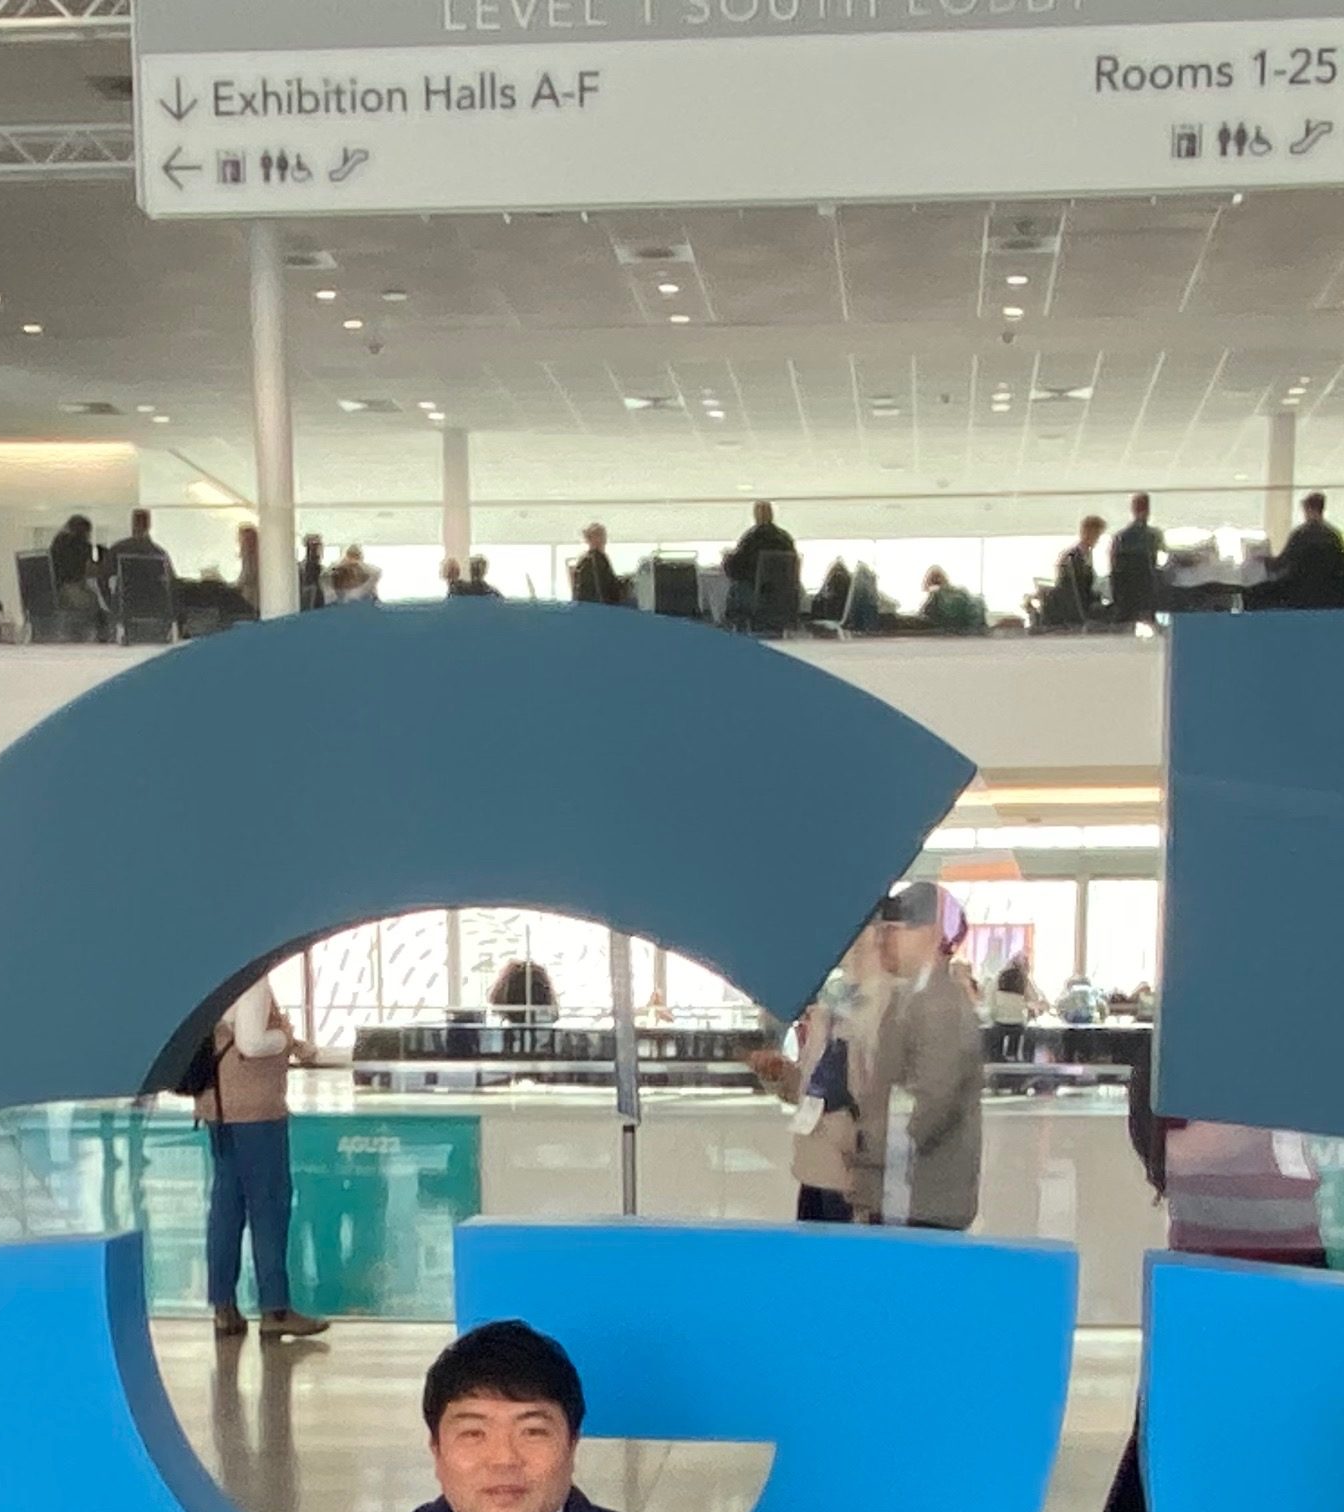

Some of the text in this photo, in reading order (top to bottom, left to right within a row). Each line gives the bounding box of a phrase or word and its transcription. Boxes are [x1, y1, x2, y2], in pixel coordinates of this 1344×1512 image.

[444, 0, 607, 30] LEVEL
[1094, 47, 1339, 92] Rooms 1-25
[212, 70, 601, 117] Exhibition Halls A-F
